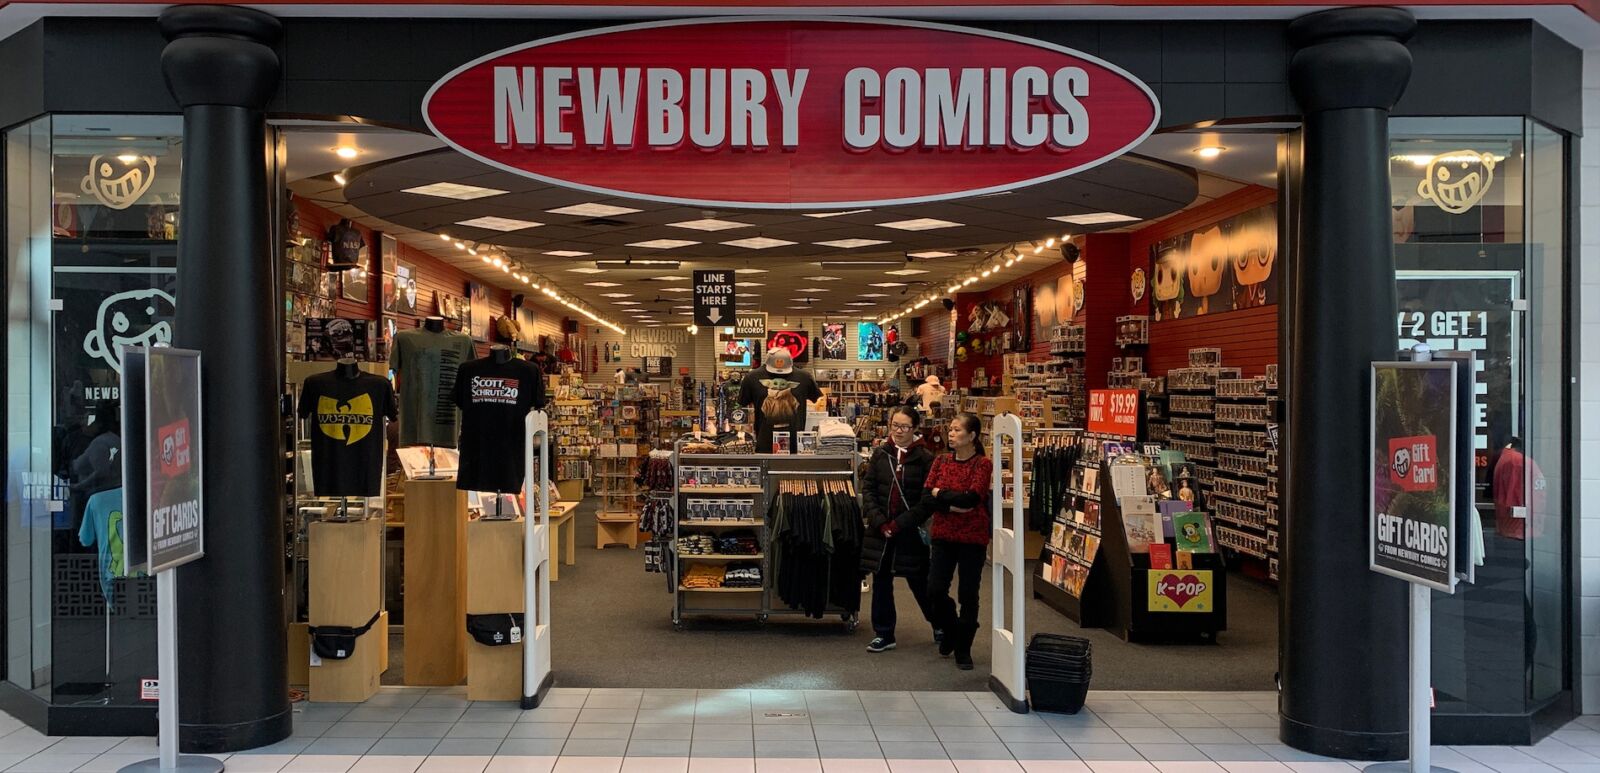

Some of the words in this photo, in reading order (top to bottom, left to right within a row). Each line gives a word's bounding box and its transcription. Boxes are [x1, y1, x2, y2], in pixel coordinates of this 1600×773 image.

[493, 66, 809, 148] NEWBURY
[843, 66, 1091, 149] COMICS
[343, 241, 360, 249] NAS
[703, 273, 725, 283] LINE
[696, 285, 732, 294] STARTS
[702, 296, 727, 305] HERE
[736, 318, 764, 327] VINYL
[1411, 311, 1425, 337] 2
[1430, 311, 1472, 337] GET
[1477, 311, 1488, 337] 1
[630, 327, 689, 344] NEWBURY
[630, 343, 677, 358] COMICS
[1110, 391, 1136, 417] $19.99
[1143, 444, 1161, 456] BTS
[1412, 443, 1430, 462] Gift
[1413, 464, 1436, 484] Card
[153, 506, 171, 540] GIFT
[171, 499, 199, 534] CARDS
[1377, 512, 1404, 546] GIFT
[1404, 518, 1448, 558] CARDS
[1384, 544, 1398, 556] FROM
[1156, 581, 1206, 596] K-POP
